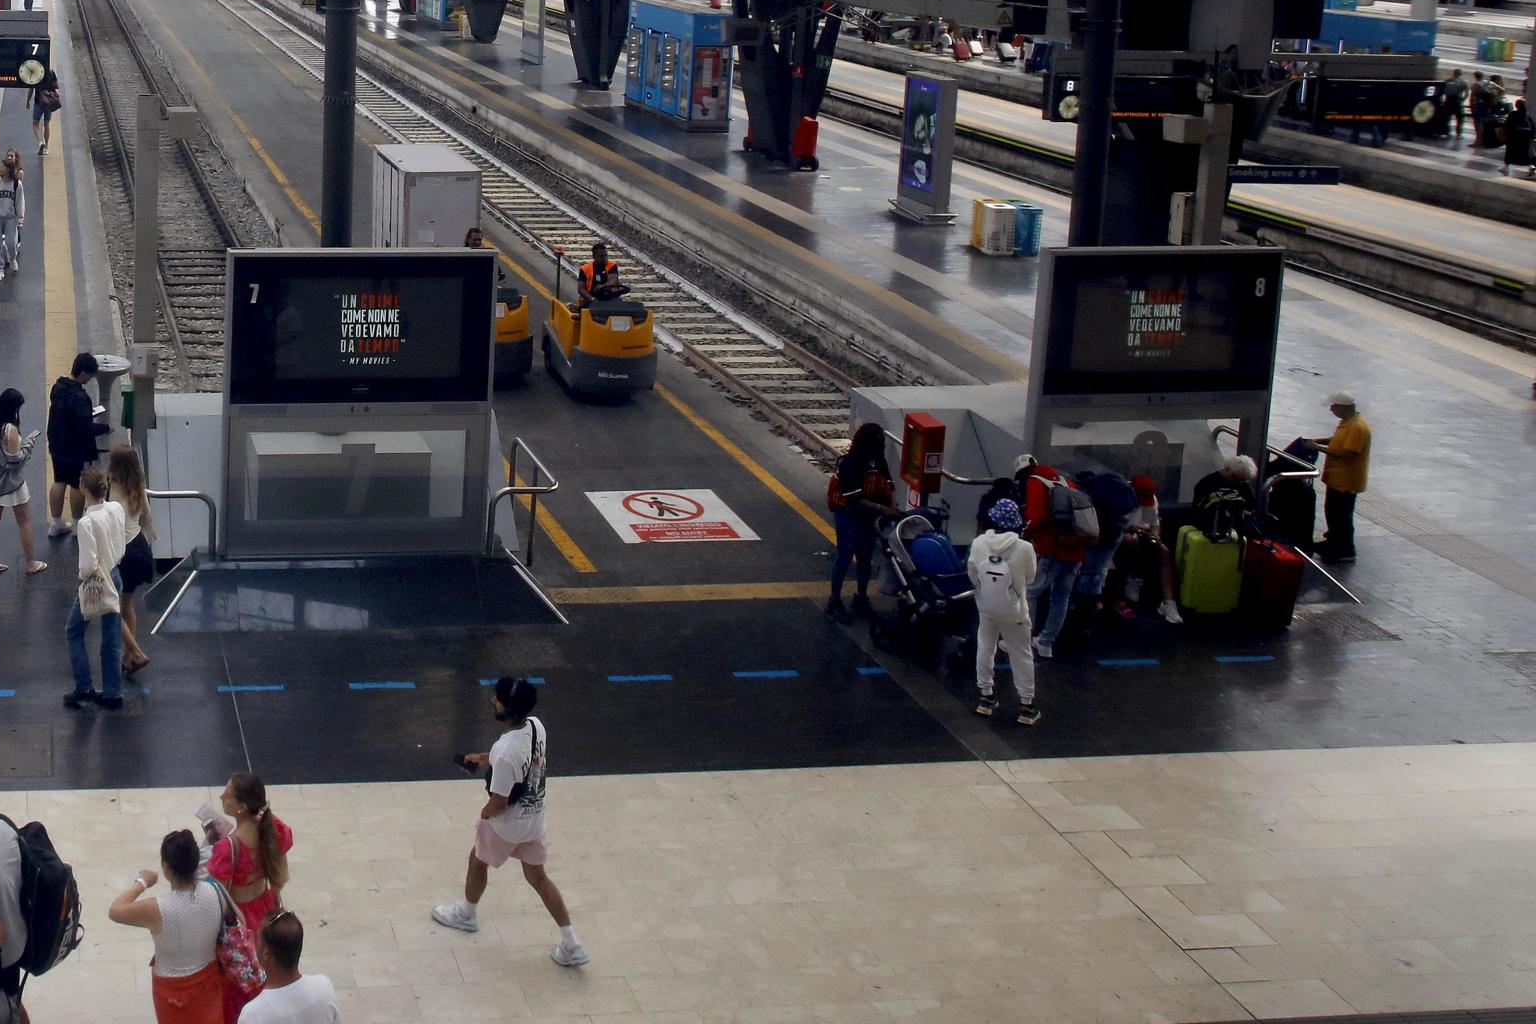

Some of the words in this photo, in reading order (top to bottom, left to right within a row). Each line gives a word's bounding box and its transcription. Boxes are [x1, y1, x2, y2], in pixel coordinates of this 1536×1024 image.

[31, 44, 39, 55] 7
[1066, 81, 1074, 91] 8
[1228, 167, 1270, 179] Smoking
[1271, 170, 1294, 178] area
[249, 283, 260, 304] 7
[1254, 277, 1266, 297] 8
[359, 293, 401, 308] CRIME
[341, 309, 367, 323] COME
[367, 309, 387, 323] NON
[387, 309, 400, 323] NE
[1130, 304, 1154, 318] COME
[1153, 304, 1171, 318] NON
[1170, 304, 1182, 317] NE
[341, 324, 400, 338] VEDEVAMO
[1129, 318, 1182, 332] VEDEVAMO
[340, 339, 355, 353] DA
[1127, 333, 1141, 347] DA
[136, 356, 143, 366] 7
[349, 357, 361, 365] MY
[362, 357, 390, 365] MOVIES
